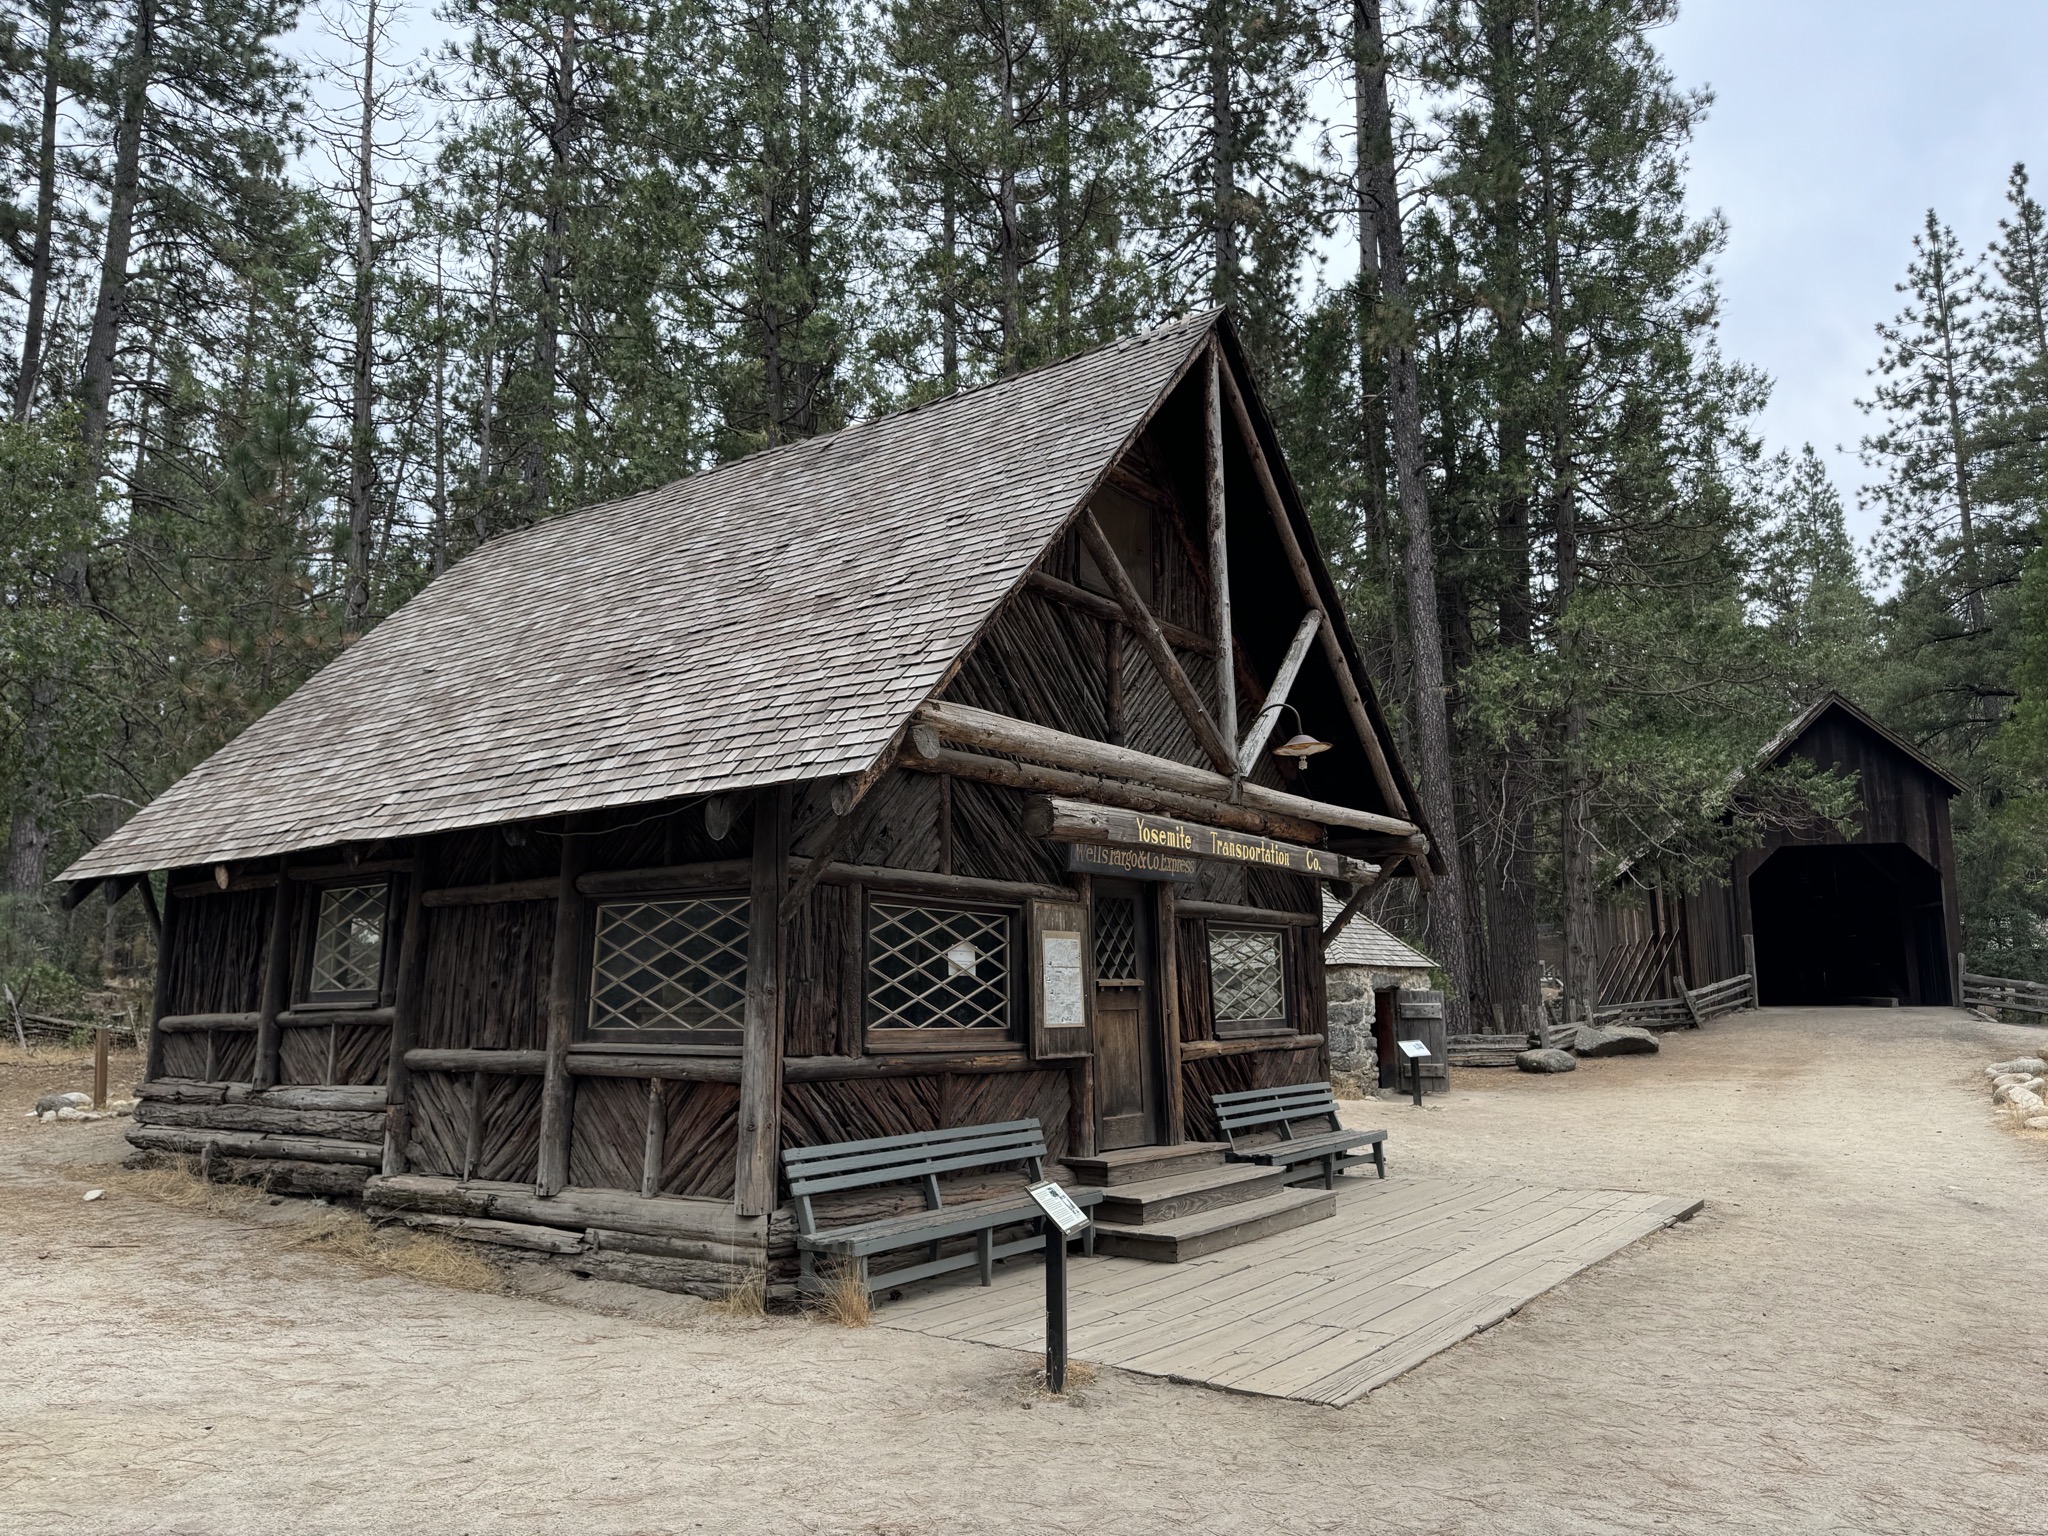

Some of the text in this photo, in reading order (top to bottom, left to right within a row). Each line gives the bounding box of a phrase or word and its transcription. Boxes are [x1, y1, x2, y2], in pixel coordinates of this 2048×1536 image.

[1075, 844, 1108, 863] Wells
[1136, 817, 1322, 871] Yosemite Transportation Co.
